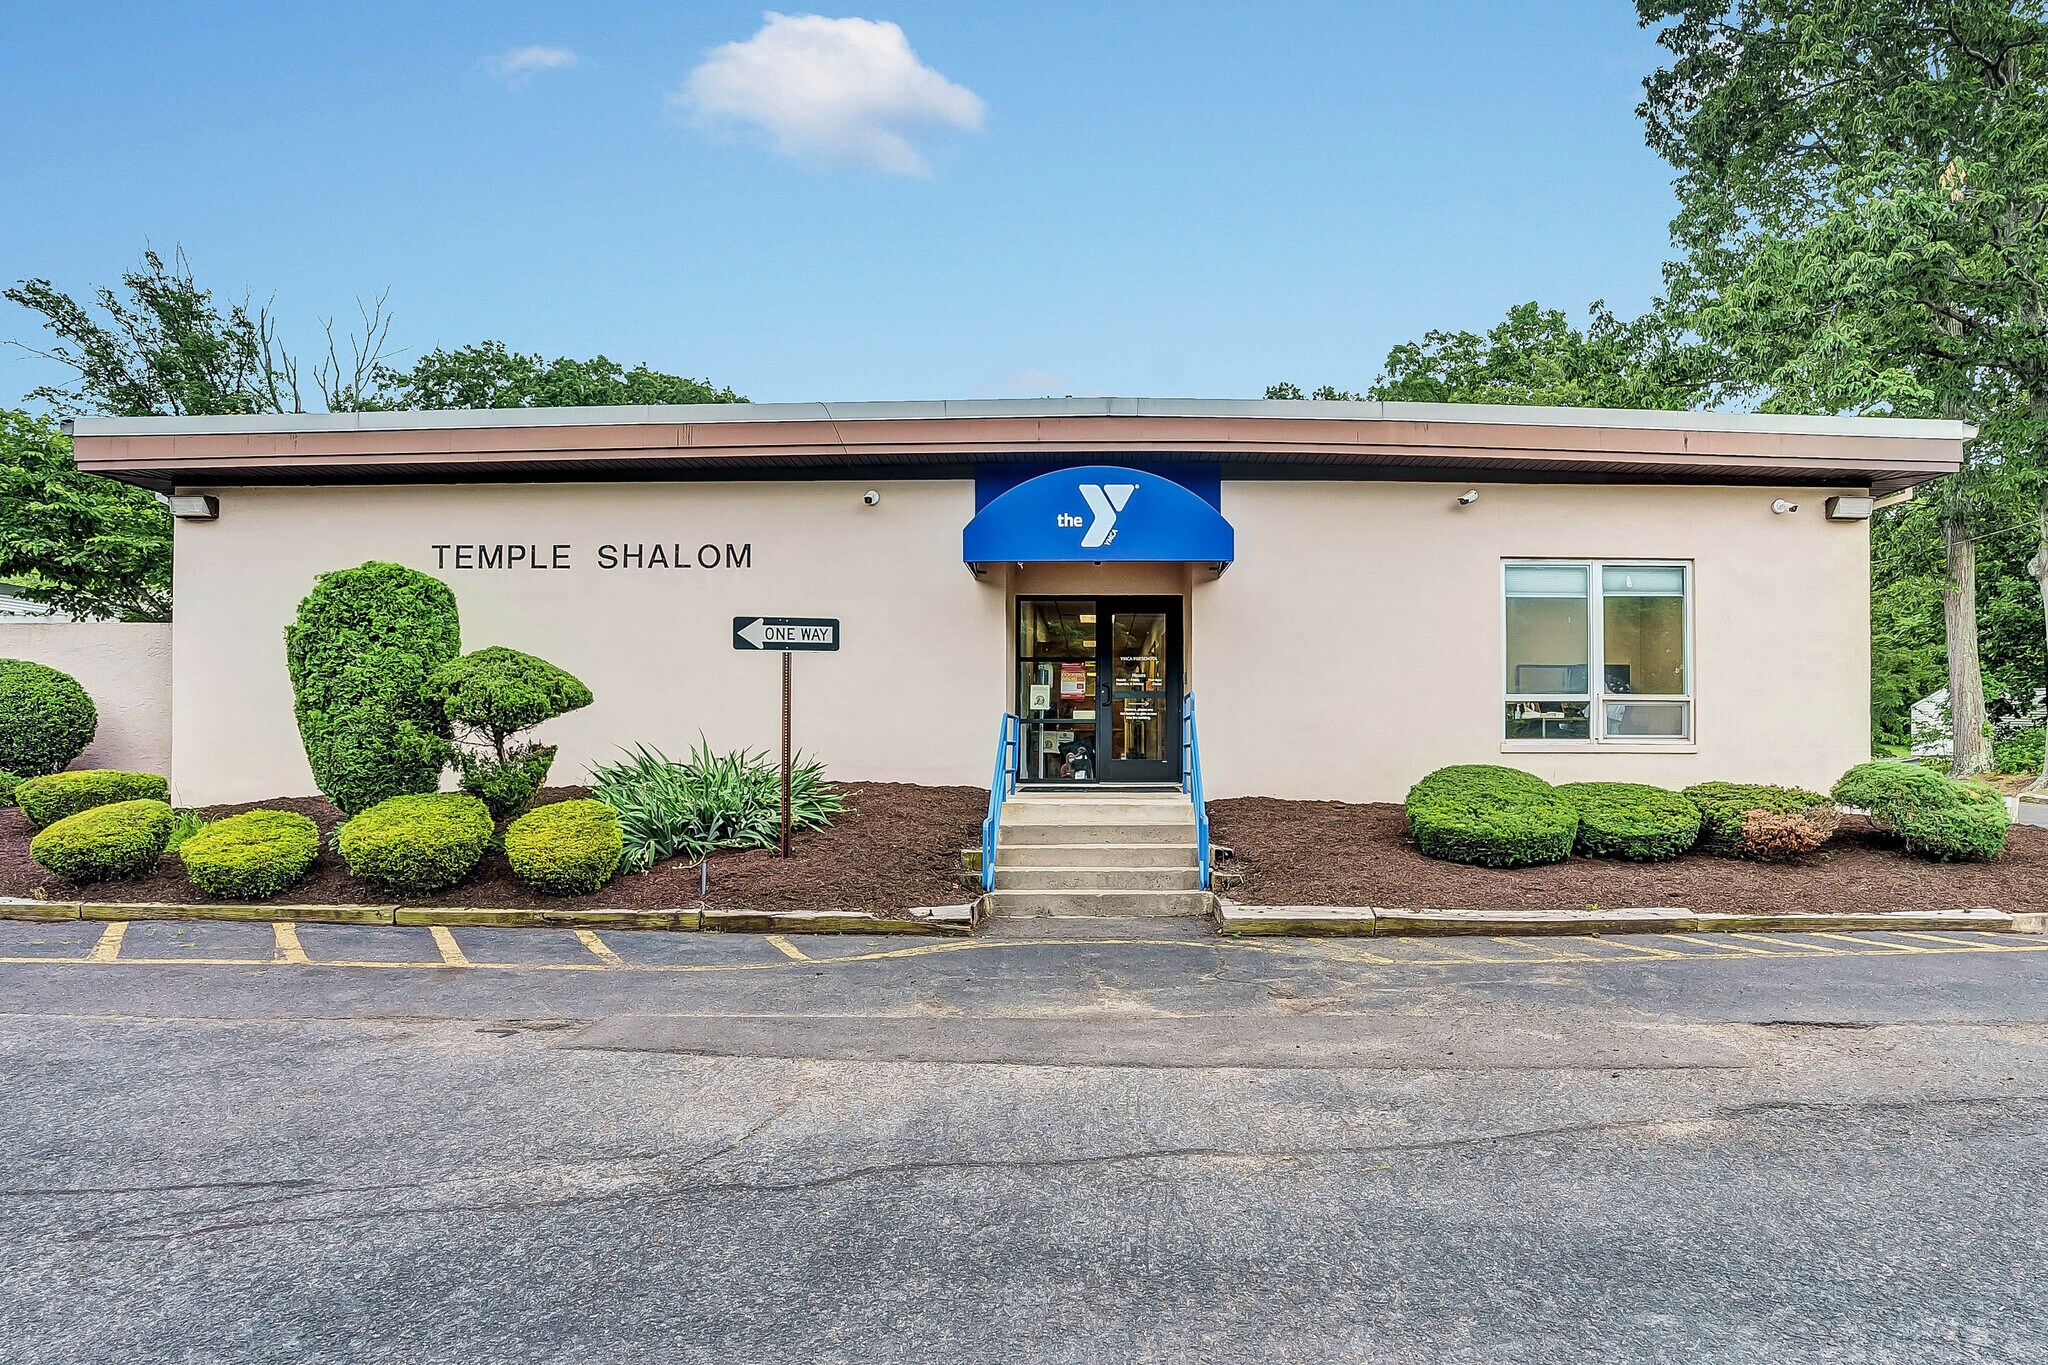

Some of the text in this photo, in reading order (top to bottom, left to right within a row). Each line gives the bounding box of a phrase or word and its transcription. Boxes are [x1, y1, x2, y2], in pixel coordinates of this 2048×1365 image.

[1057, 484, 1135, 548] the Y
[1104, 529, 1118, 546] YMCA
[431, 544, 751, 569] TEMPLE SHALOM
[765, 627, 829, 641] ONE WAY
